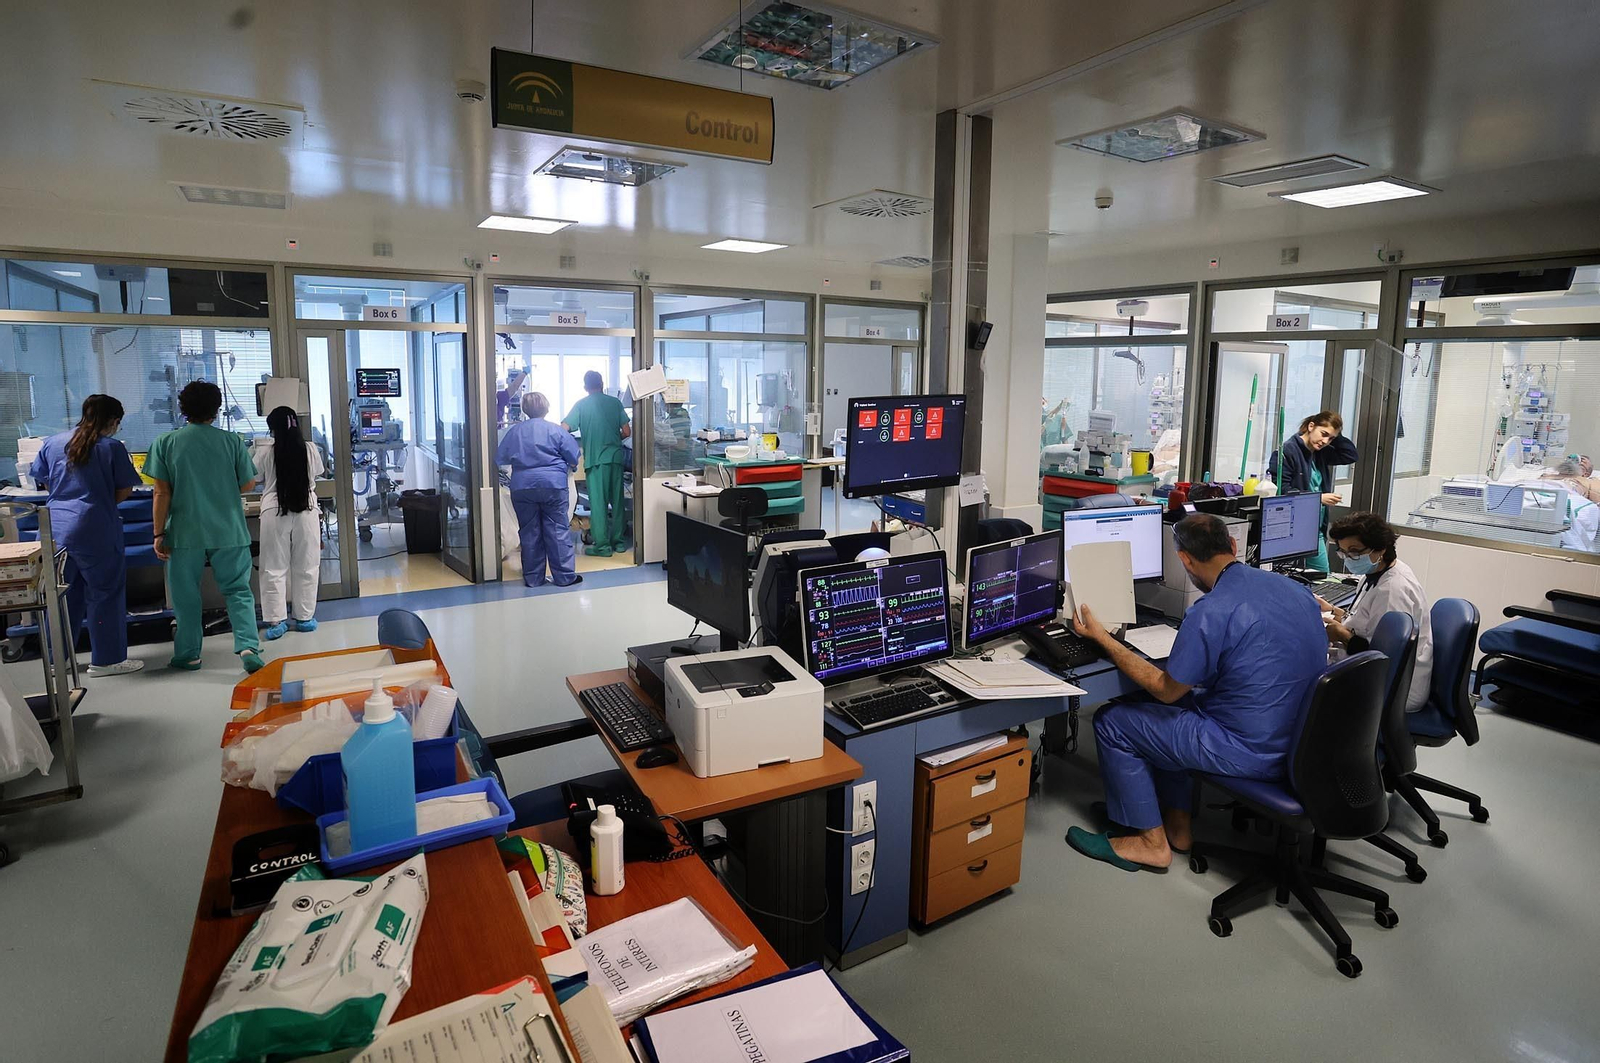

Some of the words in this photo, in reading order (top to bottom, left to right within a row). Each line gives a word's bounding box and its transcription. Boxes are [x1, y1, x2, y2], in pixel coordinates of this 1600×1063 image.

[685, 110, 758, 145] Control
[372, 309, 389, 318] Box
[391, 309, 397, 319] 6
[557, 315, 572, 324] Box
[573, 316, 579, 324] 5
[1276, 317, 1292, 328] Box
[1293, 317, 1300, 327] 2
[976, 582, 986, 592] 143
[888, 598, 898, 608] 99
[818, 610, 830, 620] 93
[249, 852, 317, 873] CONTROL
[385, 921, 395, 936] AF
[624, 938, 659, 973] INTERES
[588, 942, 630, 995] TELEFONOS
[616, 955, 633, 970] DE
